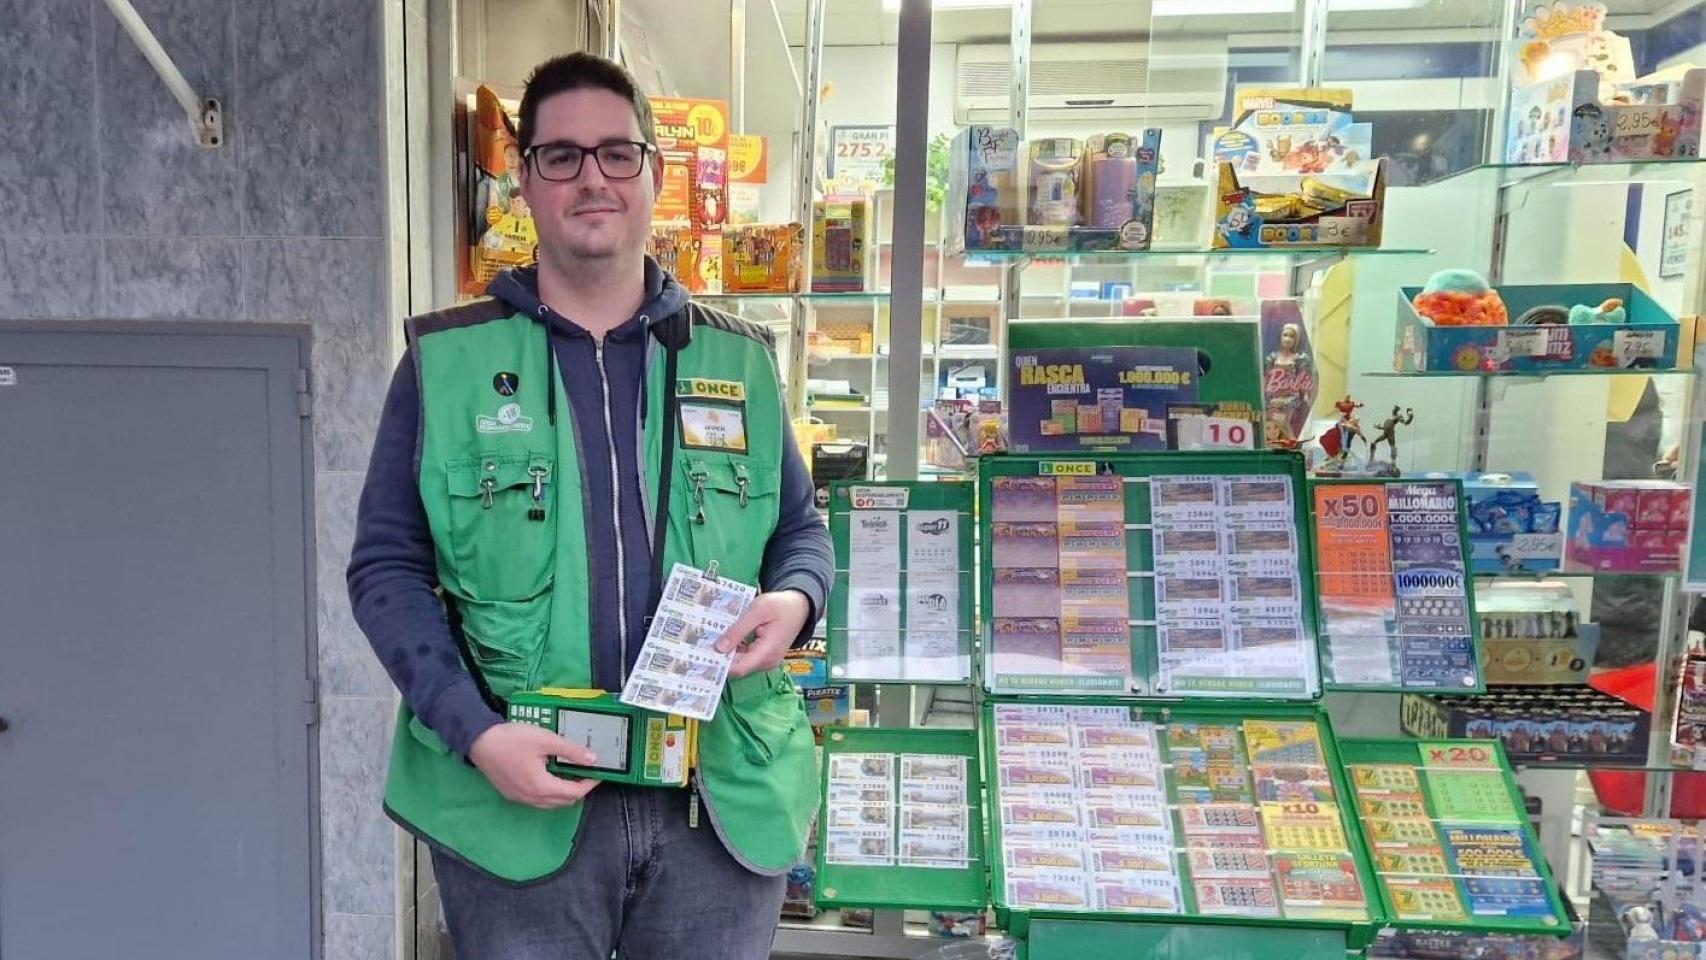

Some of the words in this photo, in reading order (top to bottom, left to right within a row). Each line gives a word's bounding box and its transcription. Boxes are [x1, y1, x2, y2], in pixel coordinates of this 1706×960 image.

[1021, 364, 1085, 385] RASCA
[1265, 368, 1314, 394] Barbie
[696, 382, 739, 397] ONCE
[1047, 383, 1091, 395] ENCUENTRA
[1055, 464, 1092, 473] ONCE
[1406, 485, 1437, 498] Mega
[1388, 496, 1455, 510] MILLONARIO
[807, 688, 841, 697] PIRATIX
